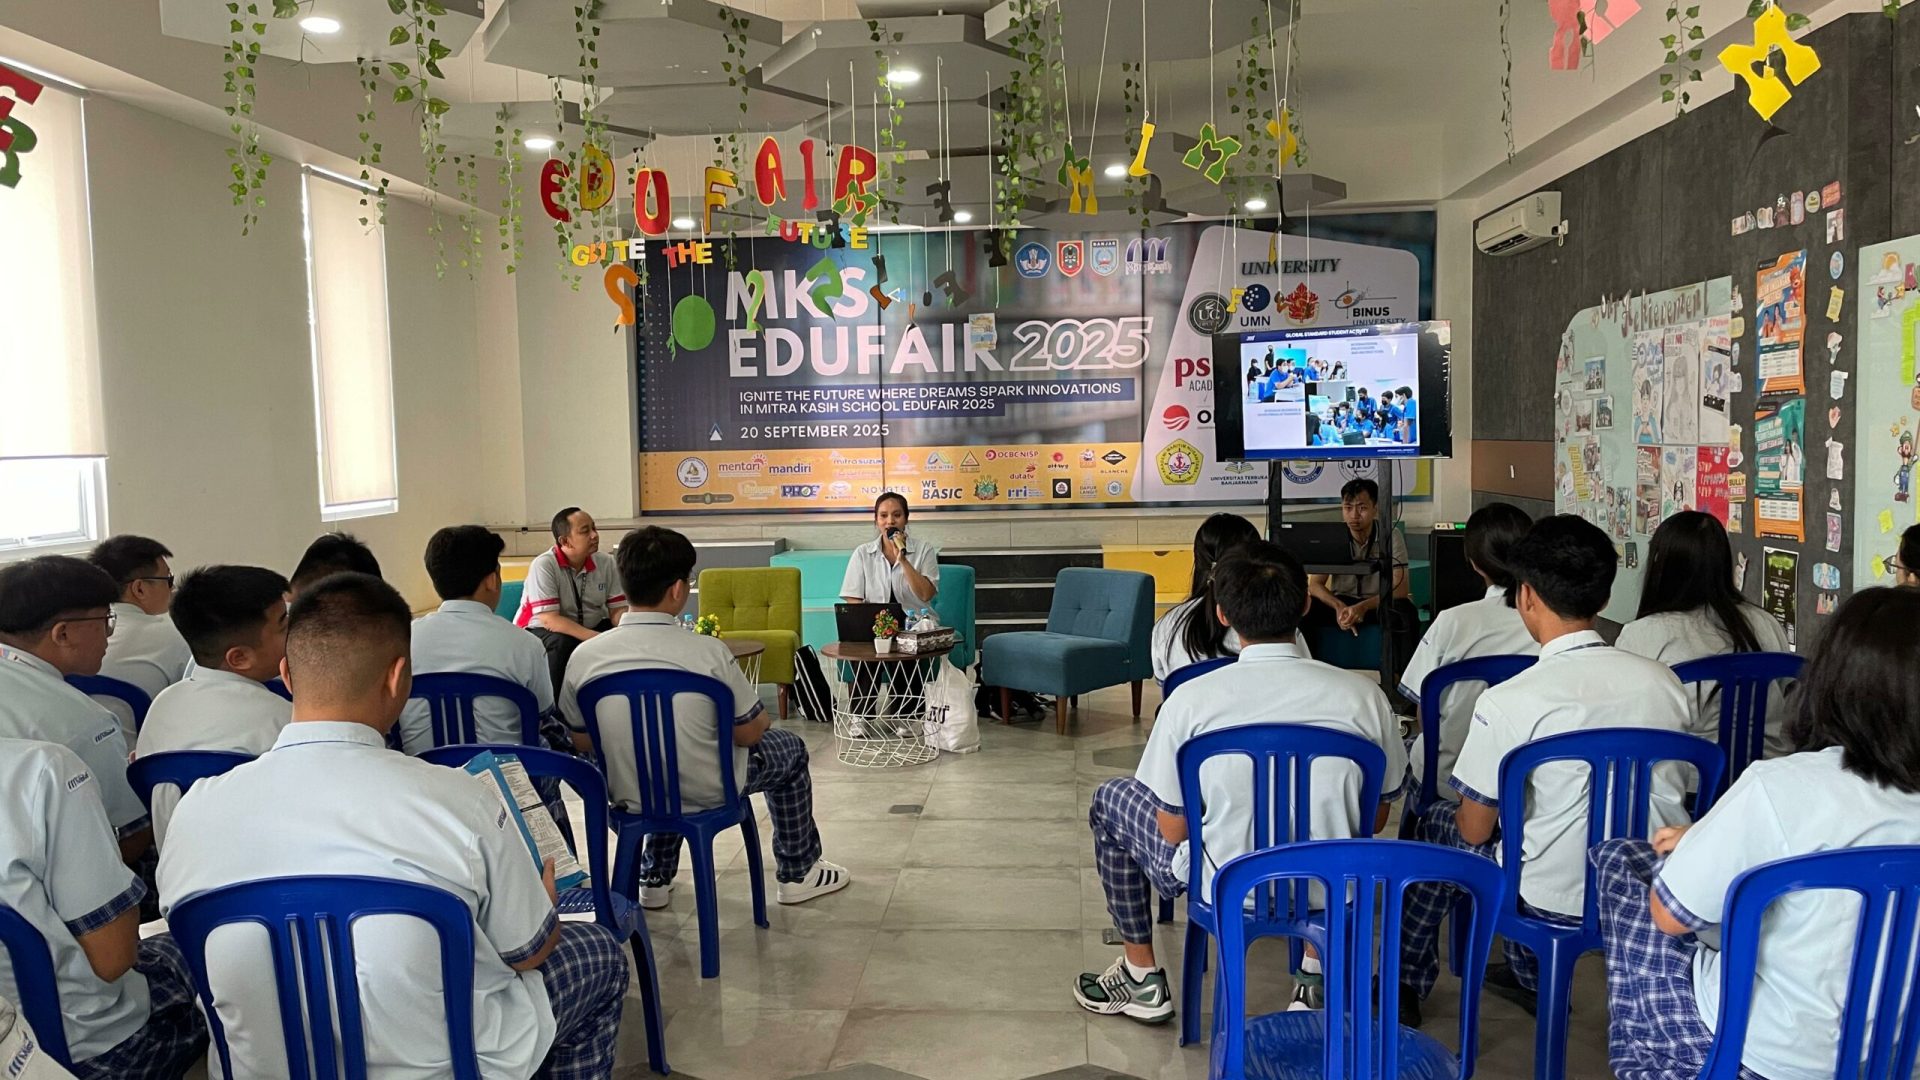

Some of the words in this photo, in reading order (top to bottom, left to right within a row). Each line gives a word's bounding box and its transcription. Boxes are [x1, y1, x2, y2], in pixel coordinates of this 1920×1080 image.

[662, 240, 713, 268] THE
[1241, 258, 1341, 276] UNIVERSITY
[725, 267, 869, 319] MKS
[1353, 307, 1390, 317] BINUS
[1240, 315, 1271, 327] UMN
[728, 323, 1004, 378] EDUFAIR
[1009, 316, 1154, 372] 2025
[740, 391, 782, 402] IGNITE
[785, 390, 811, 401] THE
[814, 389, 865, 400] FUTURE
[867, 388, 916, 399] WHERE
[920, 386, 976, 398] DREAMS
[979, 385, 1024, 397] SPARK
[1027, 383, 1121, 396] INNOVATIONS
[740, 404, 752, 414] IN
[756, 403, 797, 414] MITRA
[800, 402, 839, 413] KASIH
[842, 401, 899, 412] SCHOOL
[903, 399, 959, 411] EDUFAIR
[962, 399, 995, 410] 2025
[740, 427, 758, 439] 20
[764, 425, 848, 438] SEPTEMBER
[852, 424, 890, 437] 2025
[1020, 450, 1039, 458] NISP
[718, 462, 760, 472] mentari
[769, 463, 811, 474] mandiri
[861, 485, 912, 494] NOVOTEL
[922, 480, 937, 488] WE
[922, 488, 963, 500] BASIC
[1008, 486, 1027, 497] rri
[1730, 487, 1744, 495] FREE
